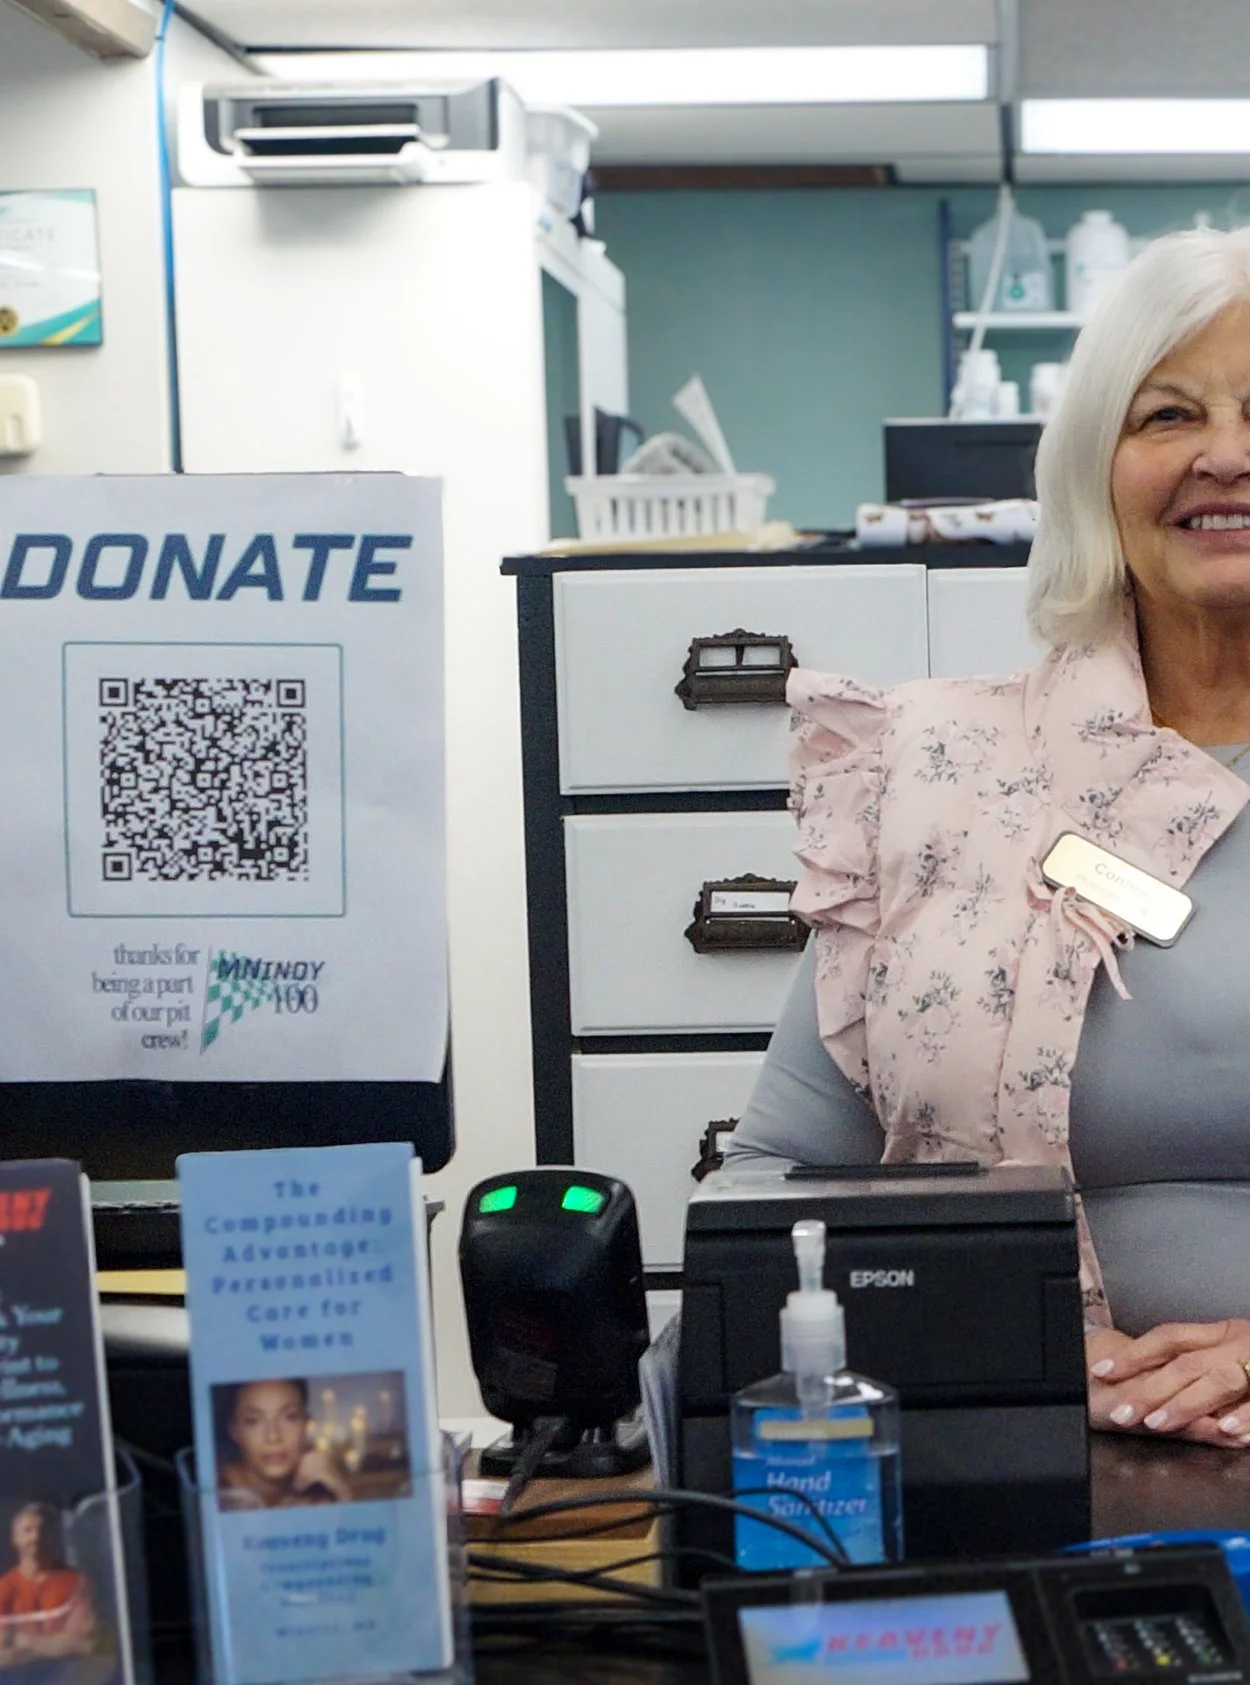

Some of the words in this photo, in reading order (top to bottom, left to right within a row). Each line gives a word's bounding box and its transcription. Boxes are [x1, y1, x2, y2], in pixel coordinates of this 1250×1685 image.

[0, 534, 413, 601] DONATE
[113, 943, 172, 965] thanks
[174, 943, 200, 965] for
[91, 971, 141, 998] being
[143, 977, 156, 993] a
[156, 975, 194, 998] part
[273, 984, 319, 1014] 100
[111, 1001, 131, 1021] of
[131, 1006, 162, 1021] our
[164, 1001, 191, 1027] pit
[141, 1028, 188, 1050] crew!
[273, 1180, 319, 1198] The
[205, 1207, 392, 1234] Compounding
[212, 1264, 393, 1294] Personalized
[850, 1270, 915, 1288] EPSON
[246, 1304, 309, 1323] Care
[321, 1298, 361, 1318] for
[260, 1332, 353, 1351] Women
[766, 1471, 832, 1493] Hand
[768, 1495, 867, 1517] Santizer
